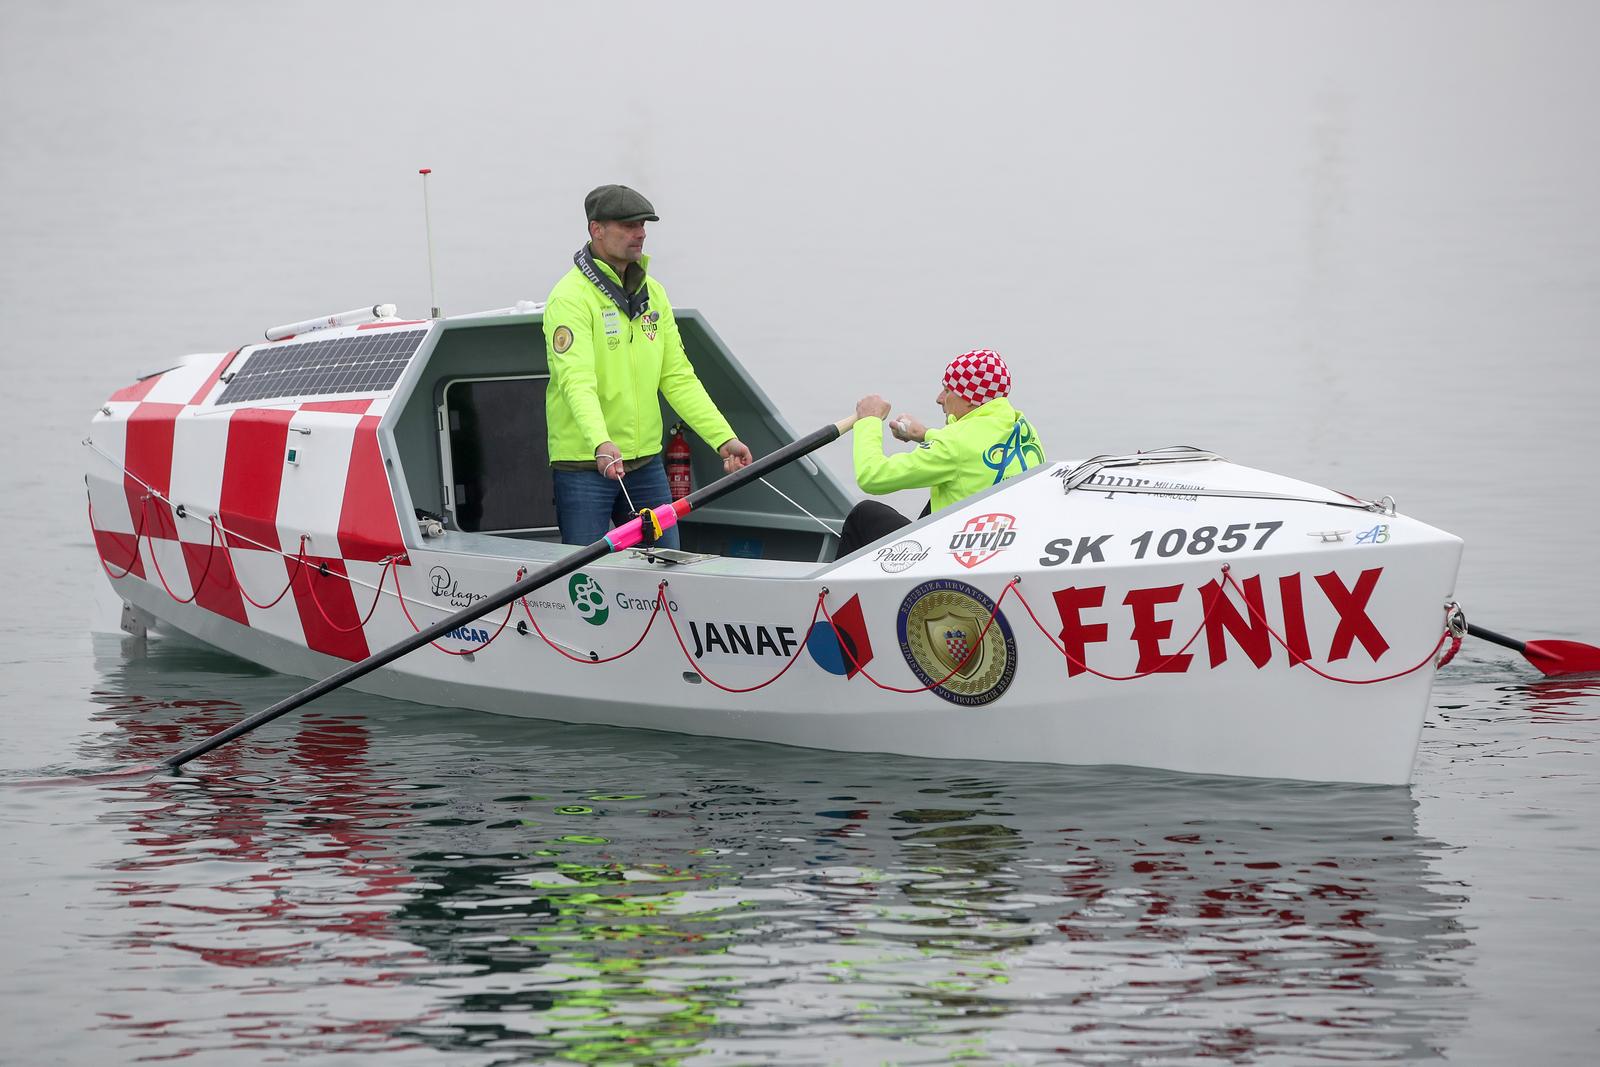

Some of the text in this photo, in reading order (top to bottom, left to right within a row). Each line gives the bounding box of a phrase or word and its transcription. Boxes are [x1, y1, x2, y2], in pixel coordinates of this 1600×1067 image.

[873, 546, 932, 562] Pedicab
[948, 527, 1017, 551] UVVID
[1039, 520, 1284, 567] SK 10857
[900, 581, 994, 614] REPUBLIKA HRVATSKA
[689, 621, 798, 659] JANAF
[1052, 566, 1391, 679] FENIX
